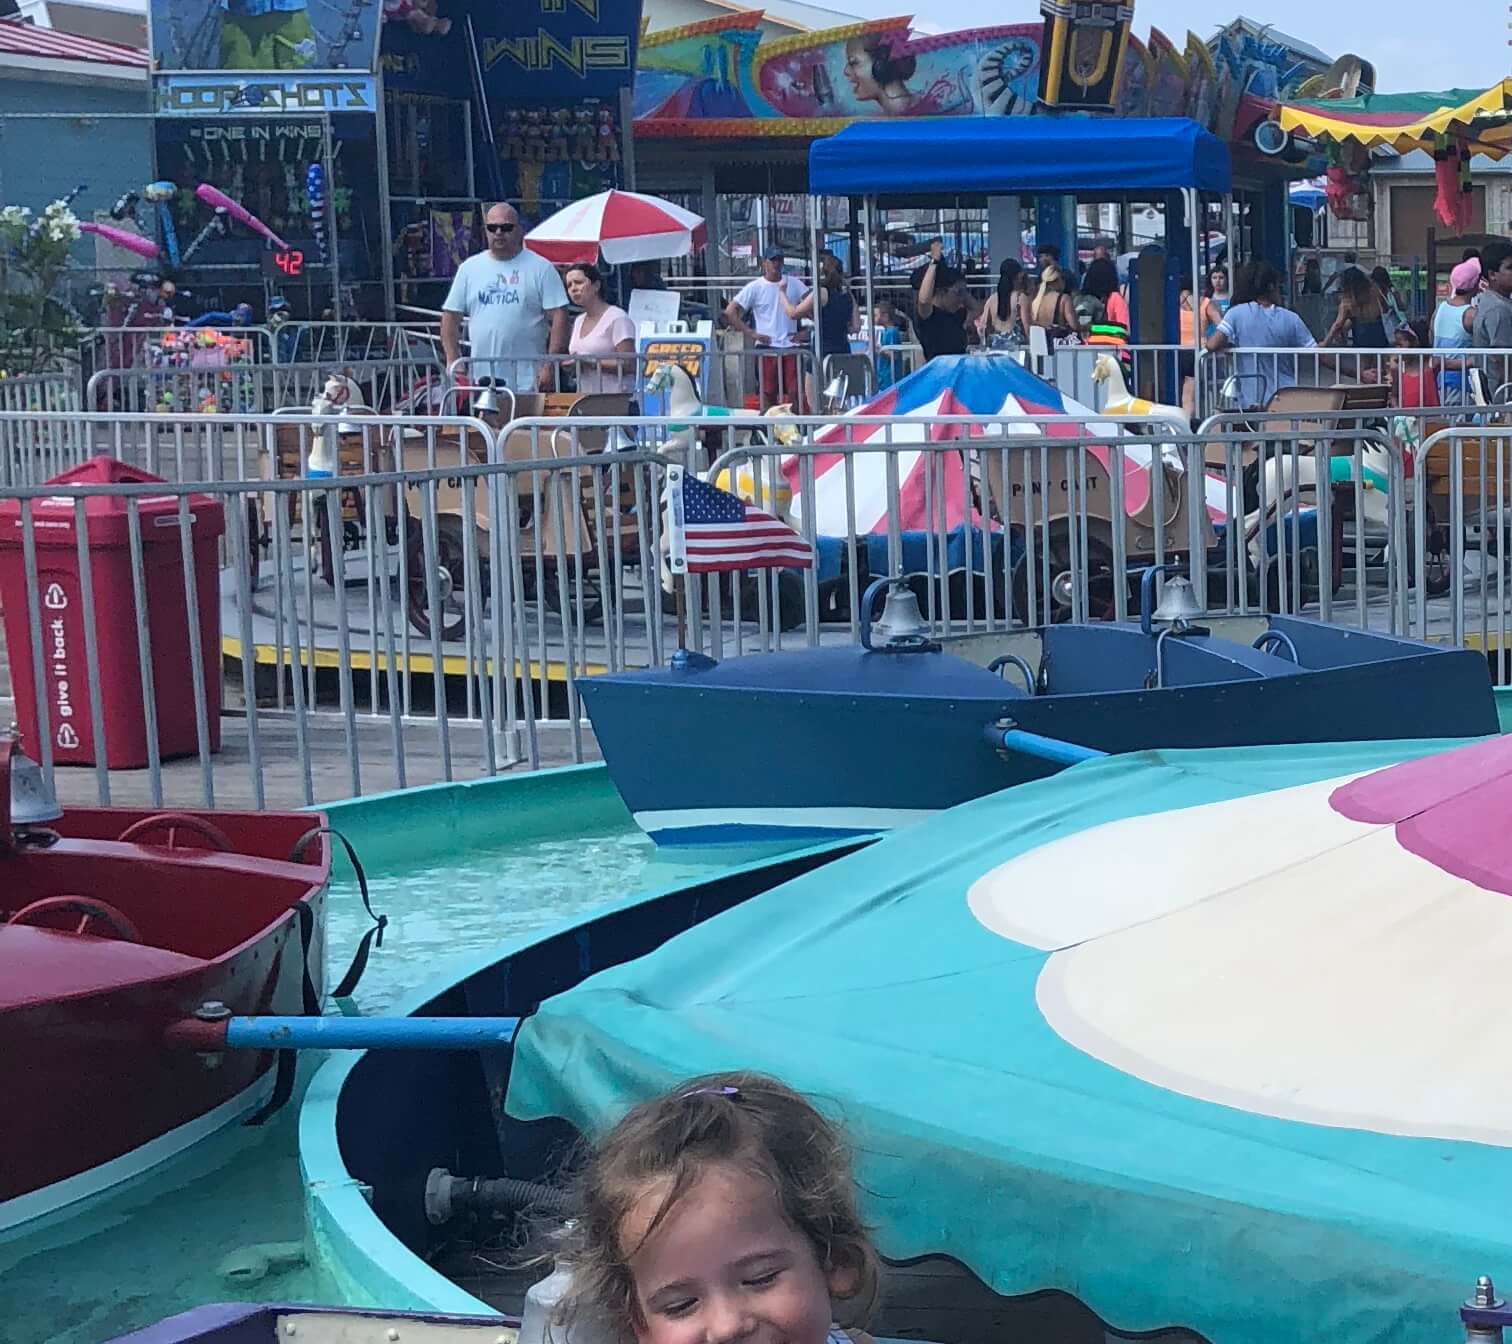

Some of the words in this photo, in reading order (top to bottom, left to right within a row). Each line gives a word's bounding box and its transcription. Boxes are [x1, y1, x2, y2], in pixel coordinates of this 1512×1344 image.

[482, 27, 631, 79] WINS
[203, 126, 246, 140] ONE
[251, 125, 270, 141] IN
[275, 123, 321, 140] WINS
[275, 250, 303, 275] 42
[51, 618, 67, 660] back
[54, 663, 68, 676] it
[56, 680, 73, 717] give
